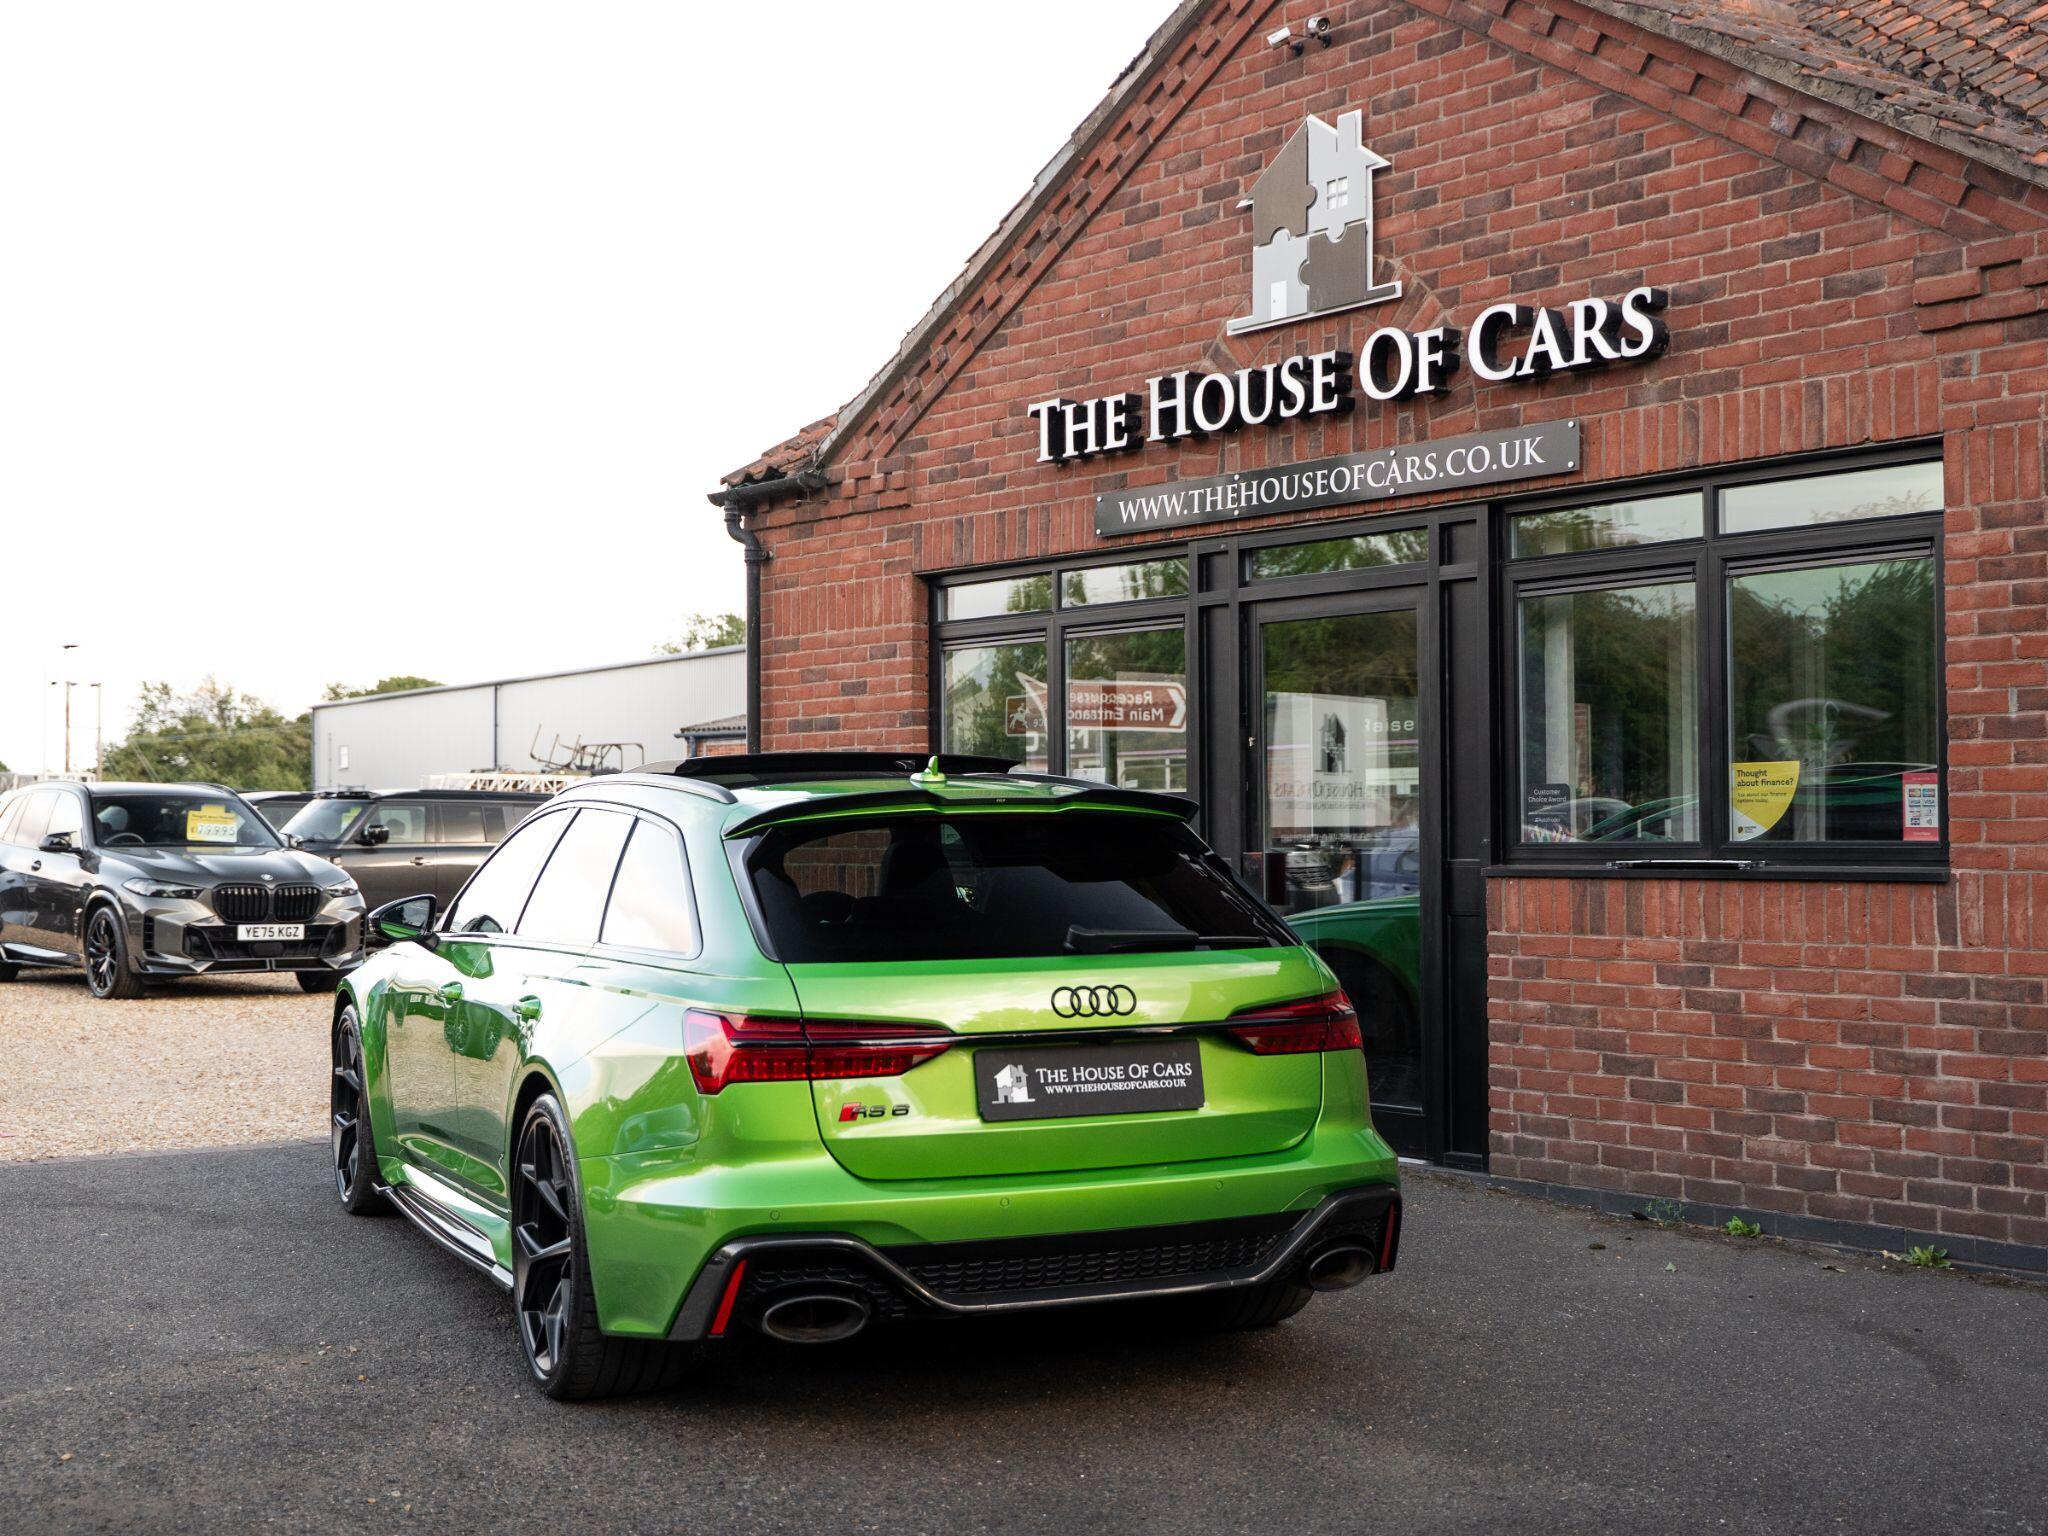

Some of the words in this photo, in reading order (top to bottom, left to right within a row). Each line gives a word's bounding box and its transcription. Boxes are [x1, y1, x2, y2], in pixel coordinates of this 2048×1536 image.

[1028, 393, 1130, 463] THE
[1146, 350, 1339, 442] HOUSE
[1360, 326, 1445, 400] OF
[1468, 286, 1655, 381] CARS
[1118, 436, 1546, 524] WWW.THEHOUSEOFCARS.CO.UK
[1736, 769, 1768, 778] Thought
[1737, 779, 1759, 787] about
[1761, 777, 1794, 787] finance?
[245, 926, 275, 938] YE75
[277, 926, 300, 938] KGZ
[1035, 1067, 1069, 1084] THE
[1073, 1065, 1125, 1082] HOUSE
[1128, 1063, 1150, 1080] OF
[1152, 1062, 1193, 1078] CARS
[891, 1103, 911, 1117] 6
